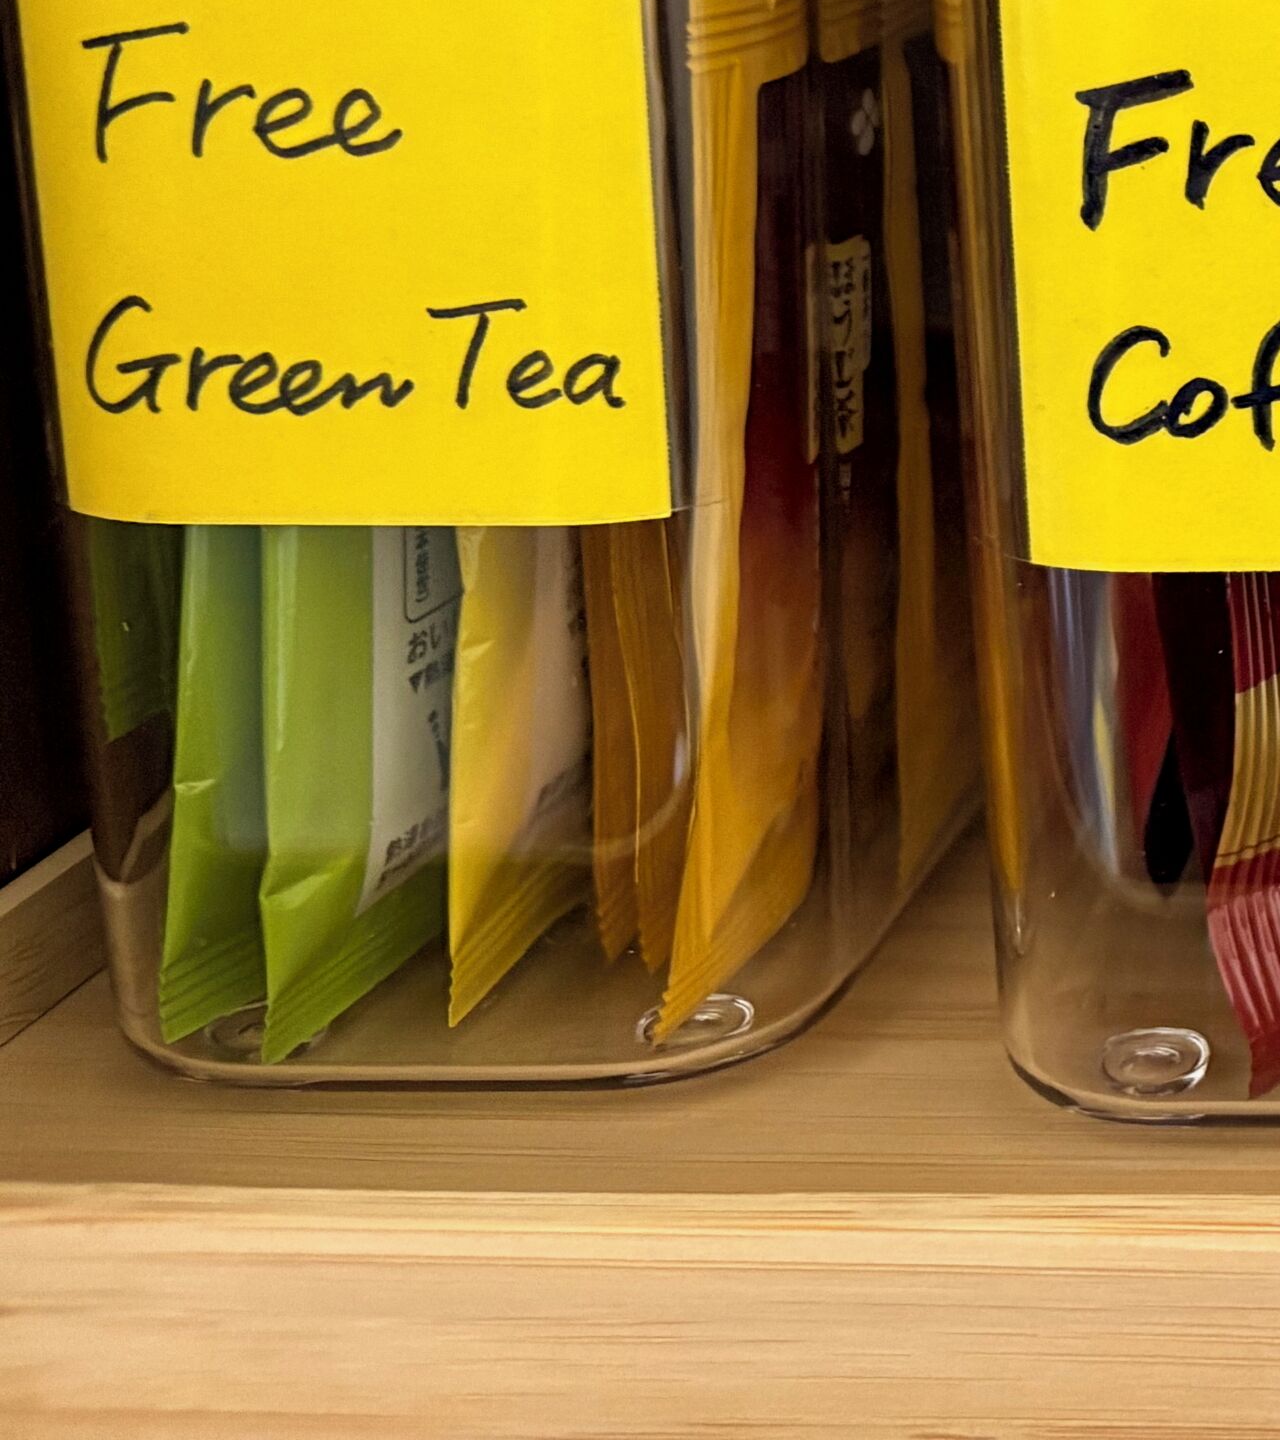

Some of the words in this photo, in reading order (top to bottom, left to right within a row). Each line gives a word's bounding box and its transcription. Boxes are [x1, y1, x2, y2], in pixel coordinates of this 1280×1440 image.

[81, 22, 402, 164] Free
[85, 295, 414, 416] Green
[427, 298, 624, 409] Tea
